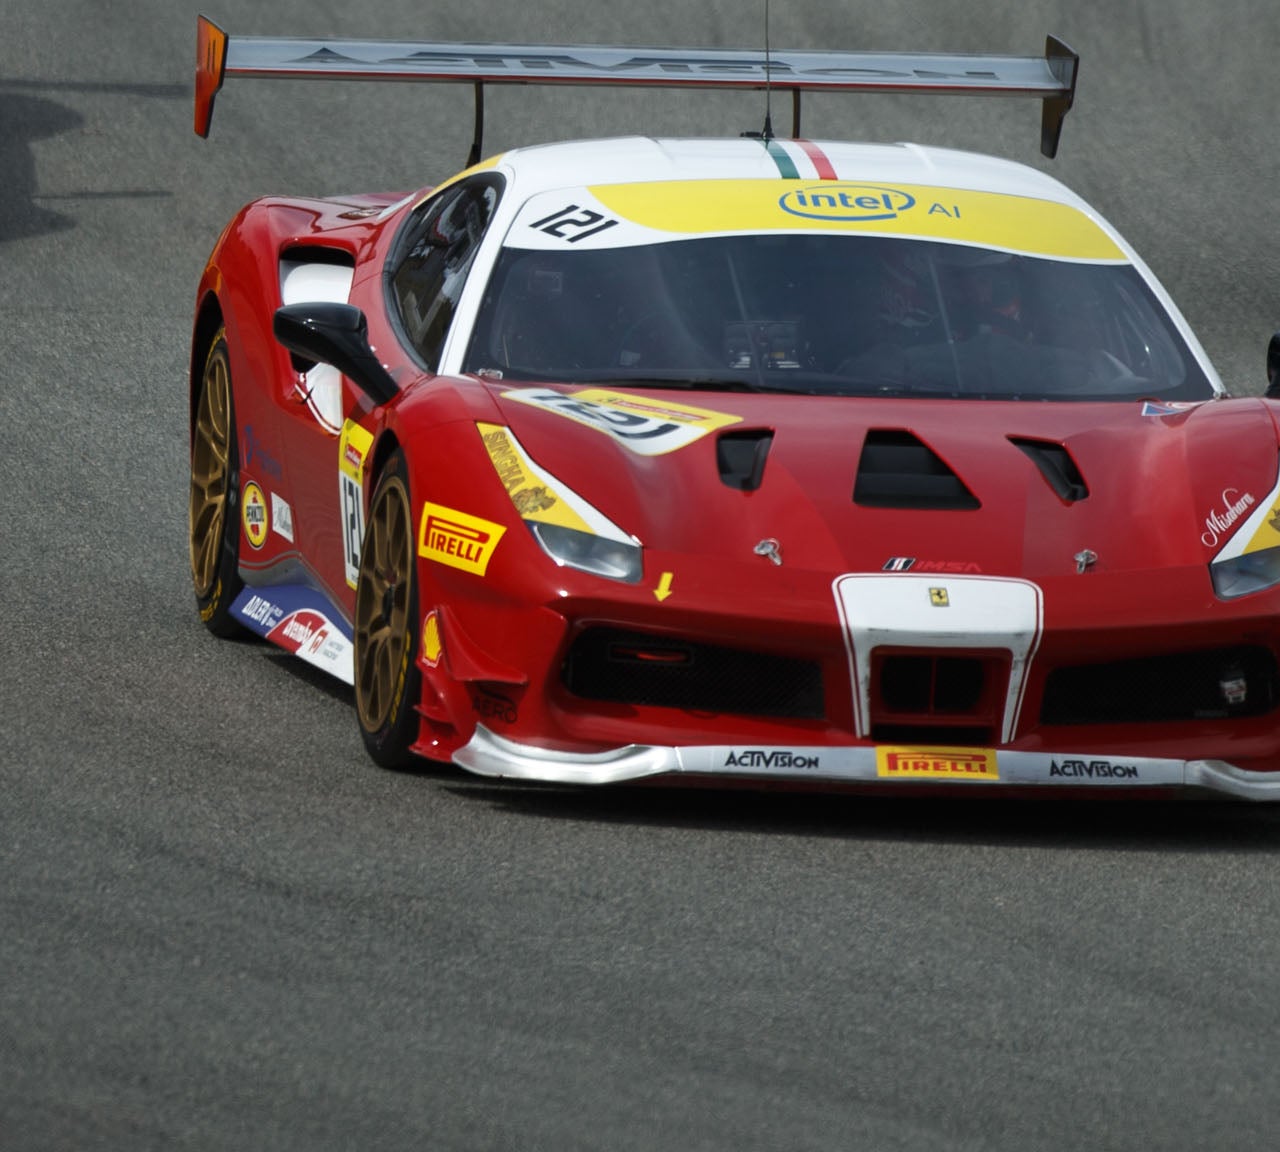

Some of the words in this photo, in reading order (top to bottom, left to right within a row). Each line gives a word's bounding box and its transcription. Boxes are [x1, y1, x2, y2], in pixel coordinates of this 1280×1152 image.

[528, 204, 619, 243] 121
[928, 203, 961, 218] AI
[531, 396, 681, 440] 121
[483, 431, 526, 492] SINGHA
[1201, 488, 1255, 547] Misahara
[424, 514, 490, 563] PIRELLI
[916, 560, 982, 572] IMSA
[473, 697, 518, 724] AERO
[887, 752, 987, 773] PIRELLI
